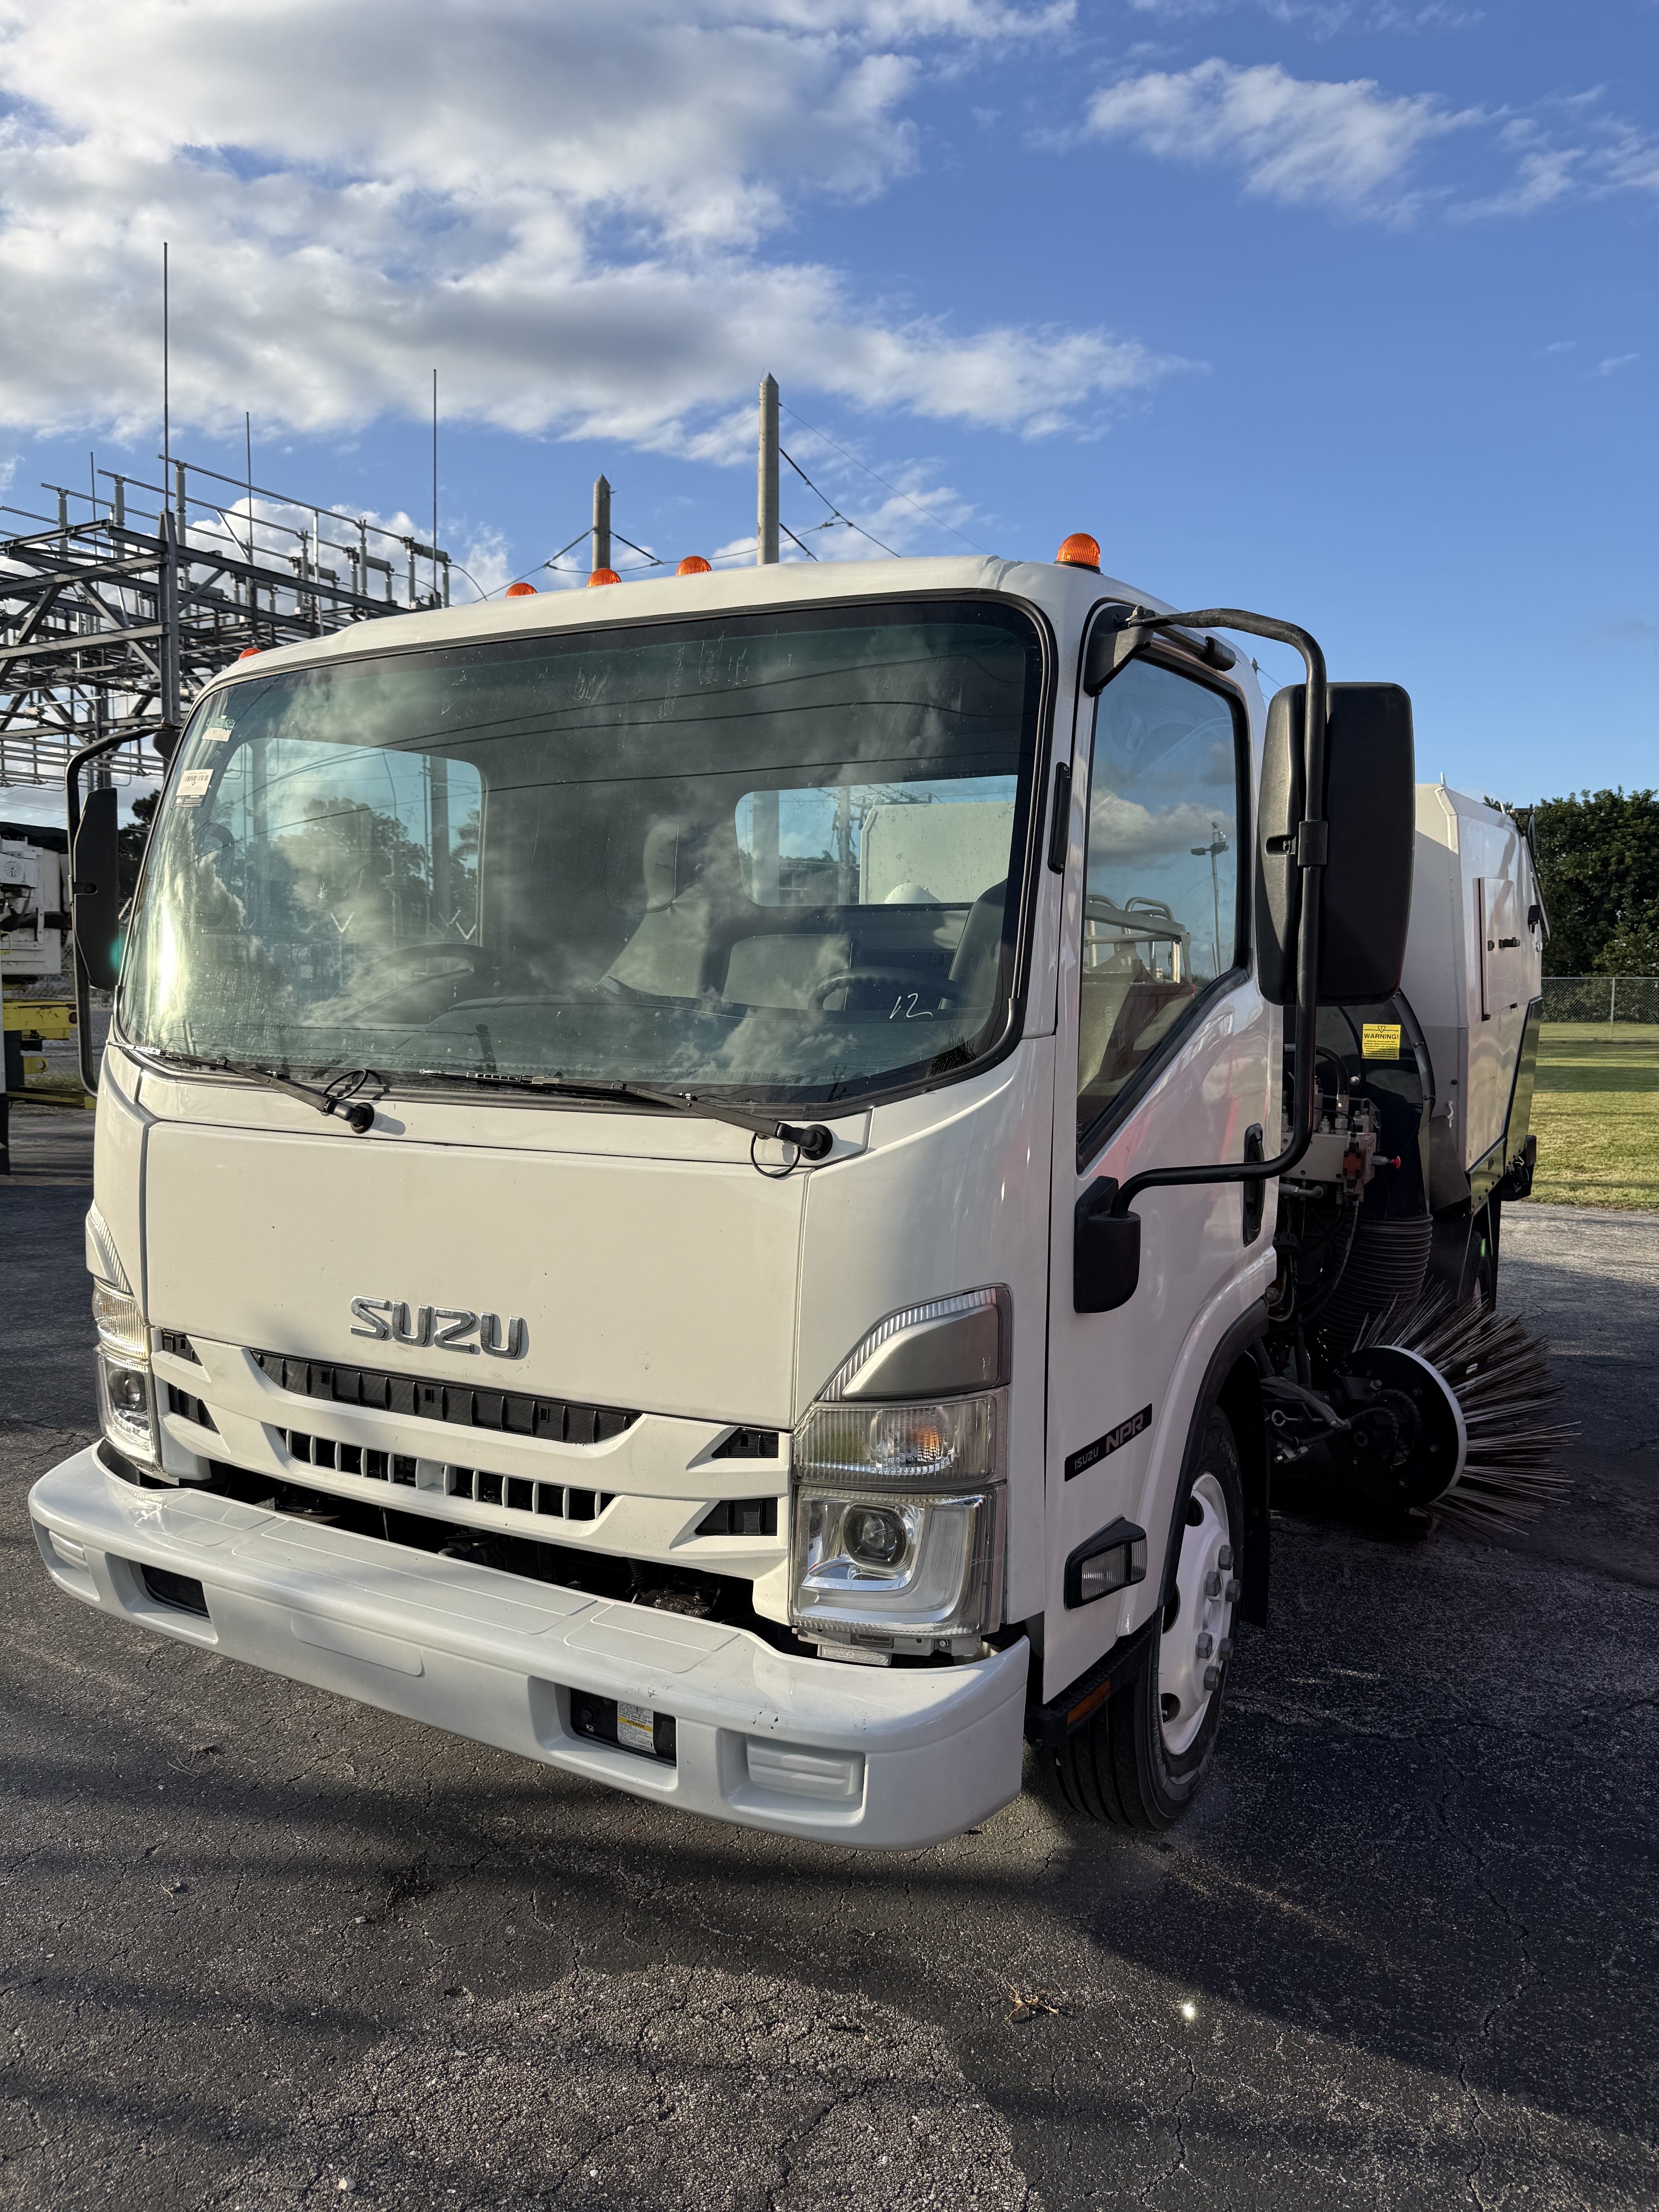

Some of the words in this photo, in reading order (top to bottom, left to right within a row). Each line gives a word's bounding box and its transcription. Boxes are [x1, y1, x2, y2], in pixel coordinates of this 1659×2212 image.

[890, 993, 933, 1019] 12
[350, 1295, 522, 1359] SUZU
[1075, 1447, 1098, 1470] ISUZU
[1106, 1413, 1143, 1454] NPR
